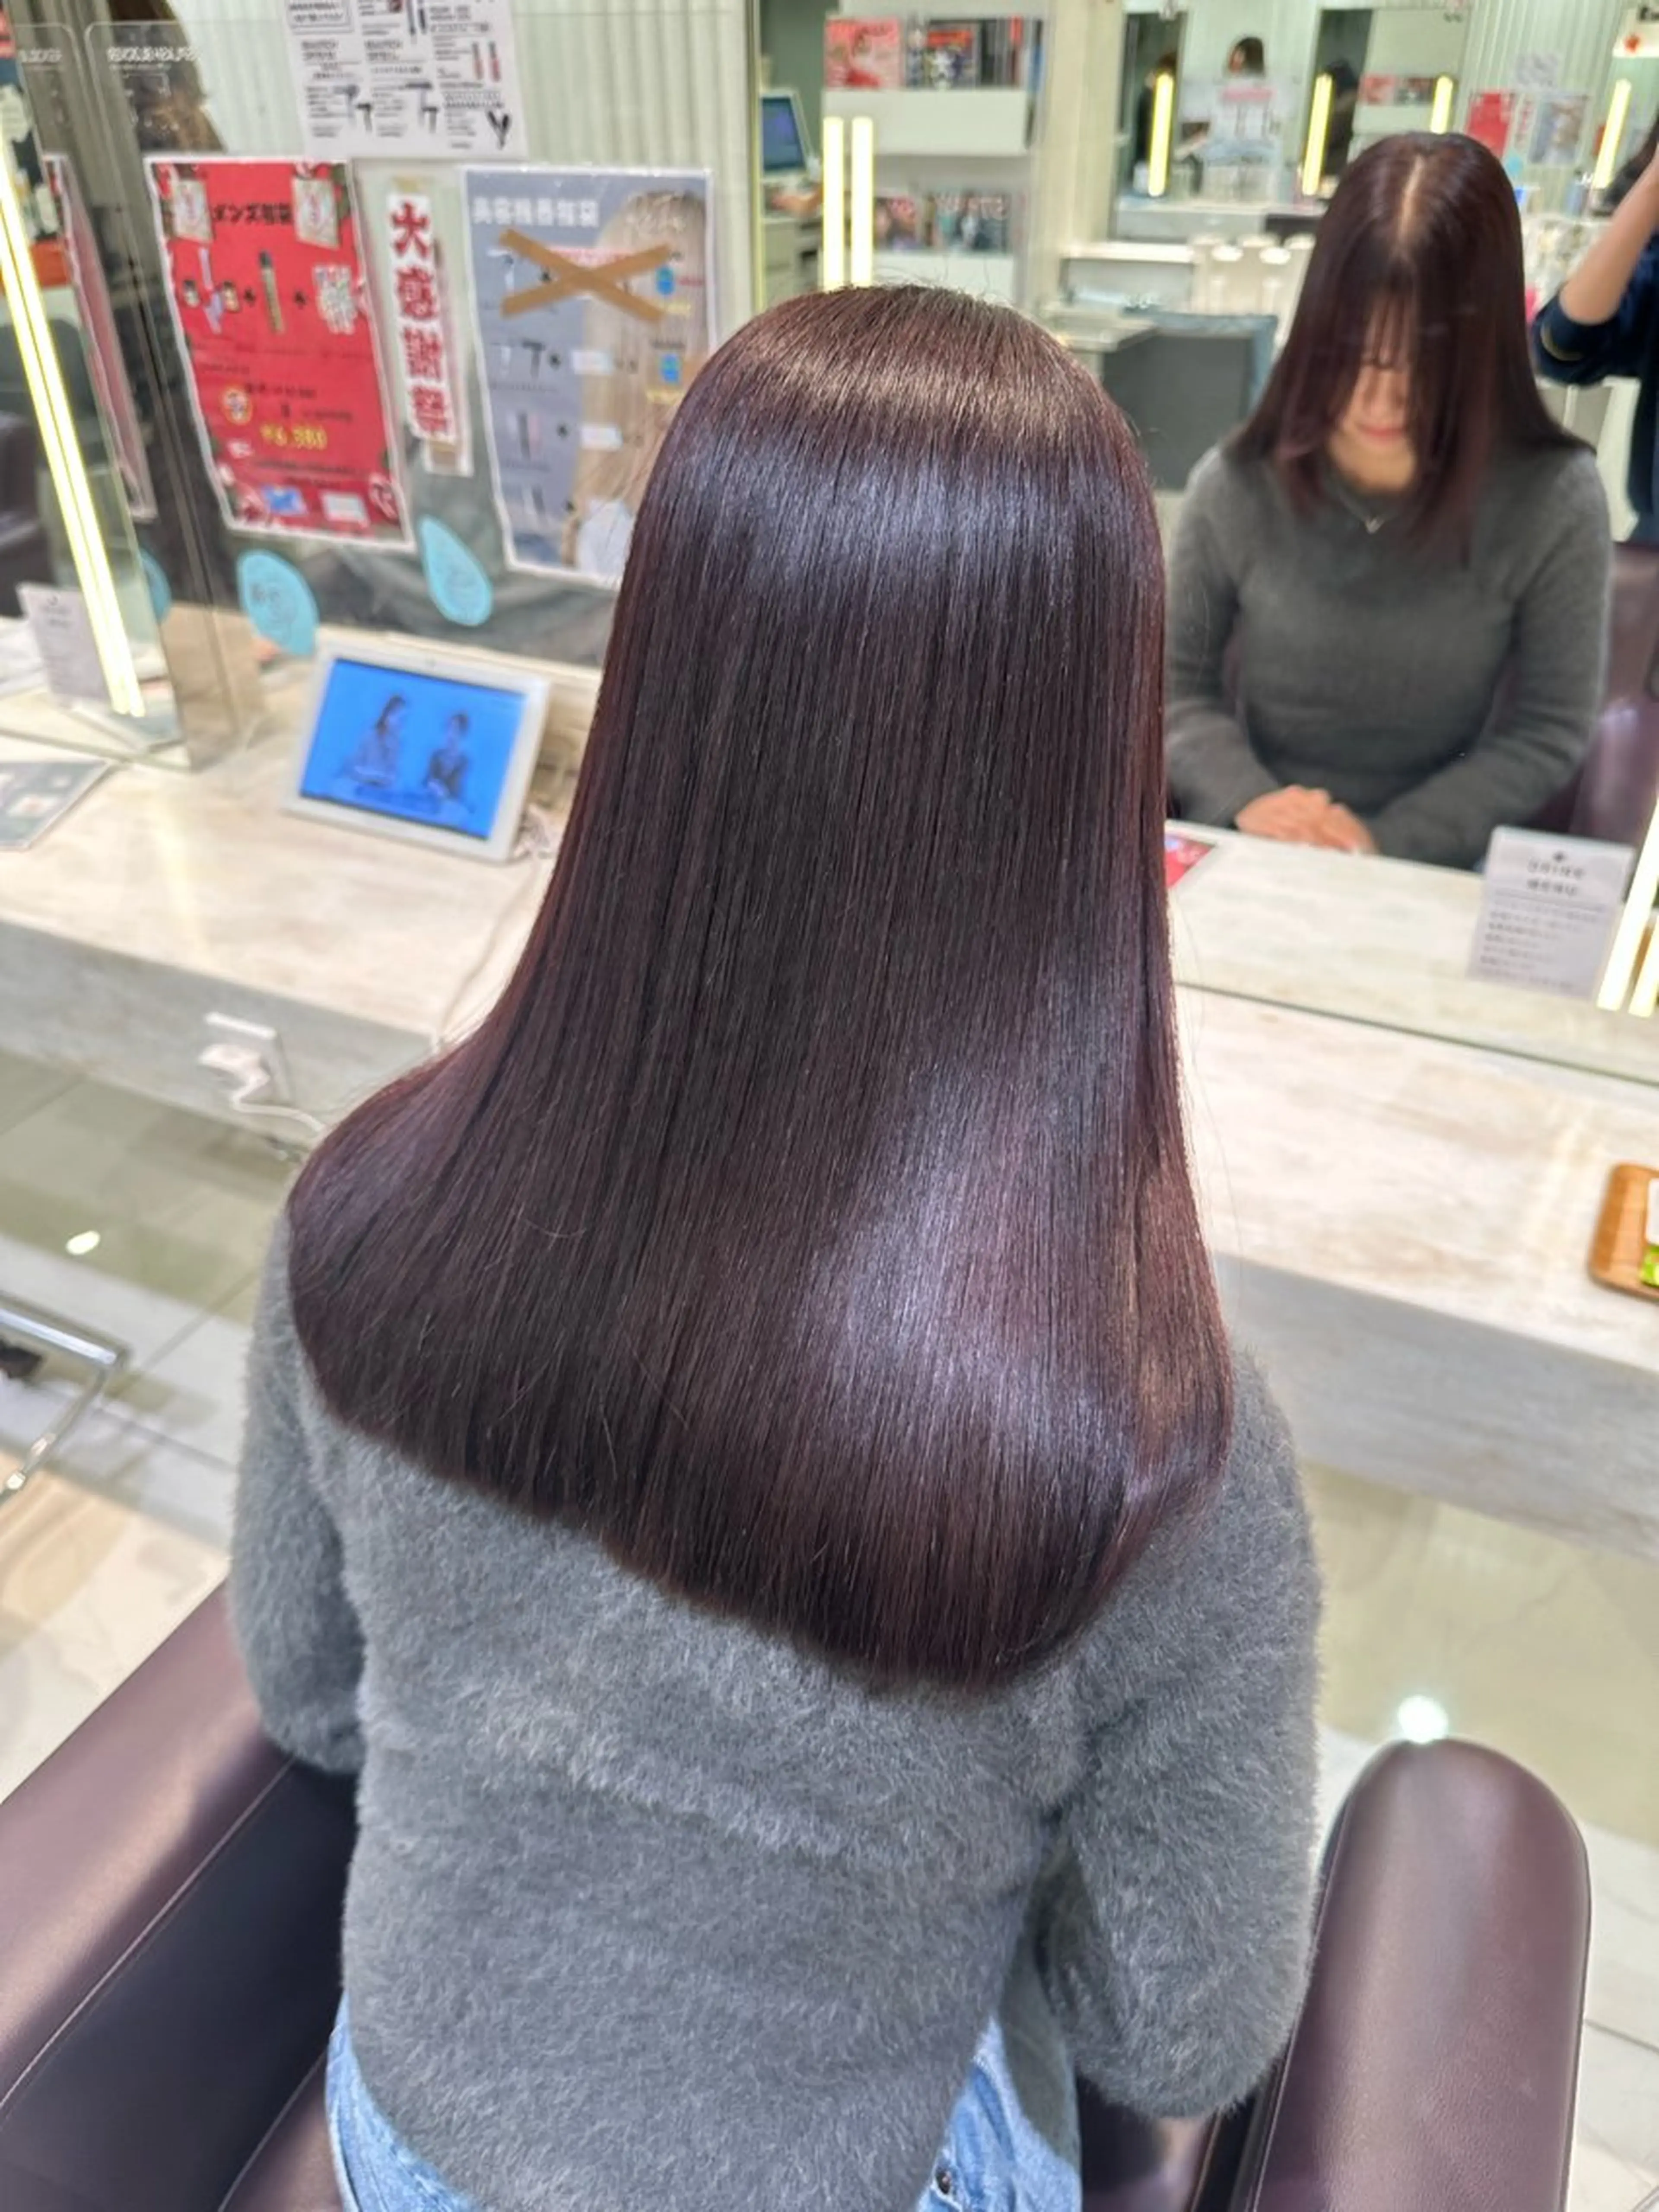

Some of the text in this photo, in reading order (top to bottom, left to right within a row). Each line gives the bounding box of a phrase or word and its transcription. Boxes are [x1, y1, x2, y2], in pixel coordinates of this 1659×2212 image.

[214, 202, 292, 225] メンズ福袋
[390, 200, 450, 434] 大感謝祭
